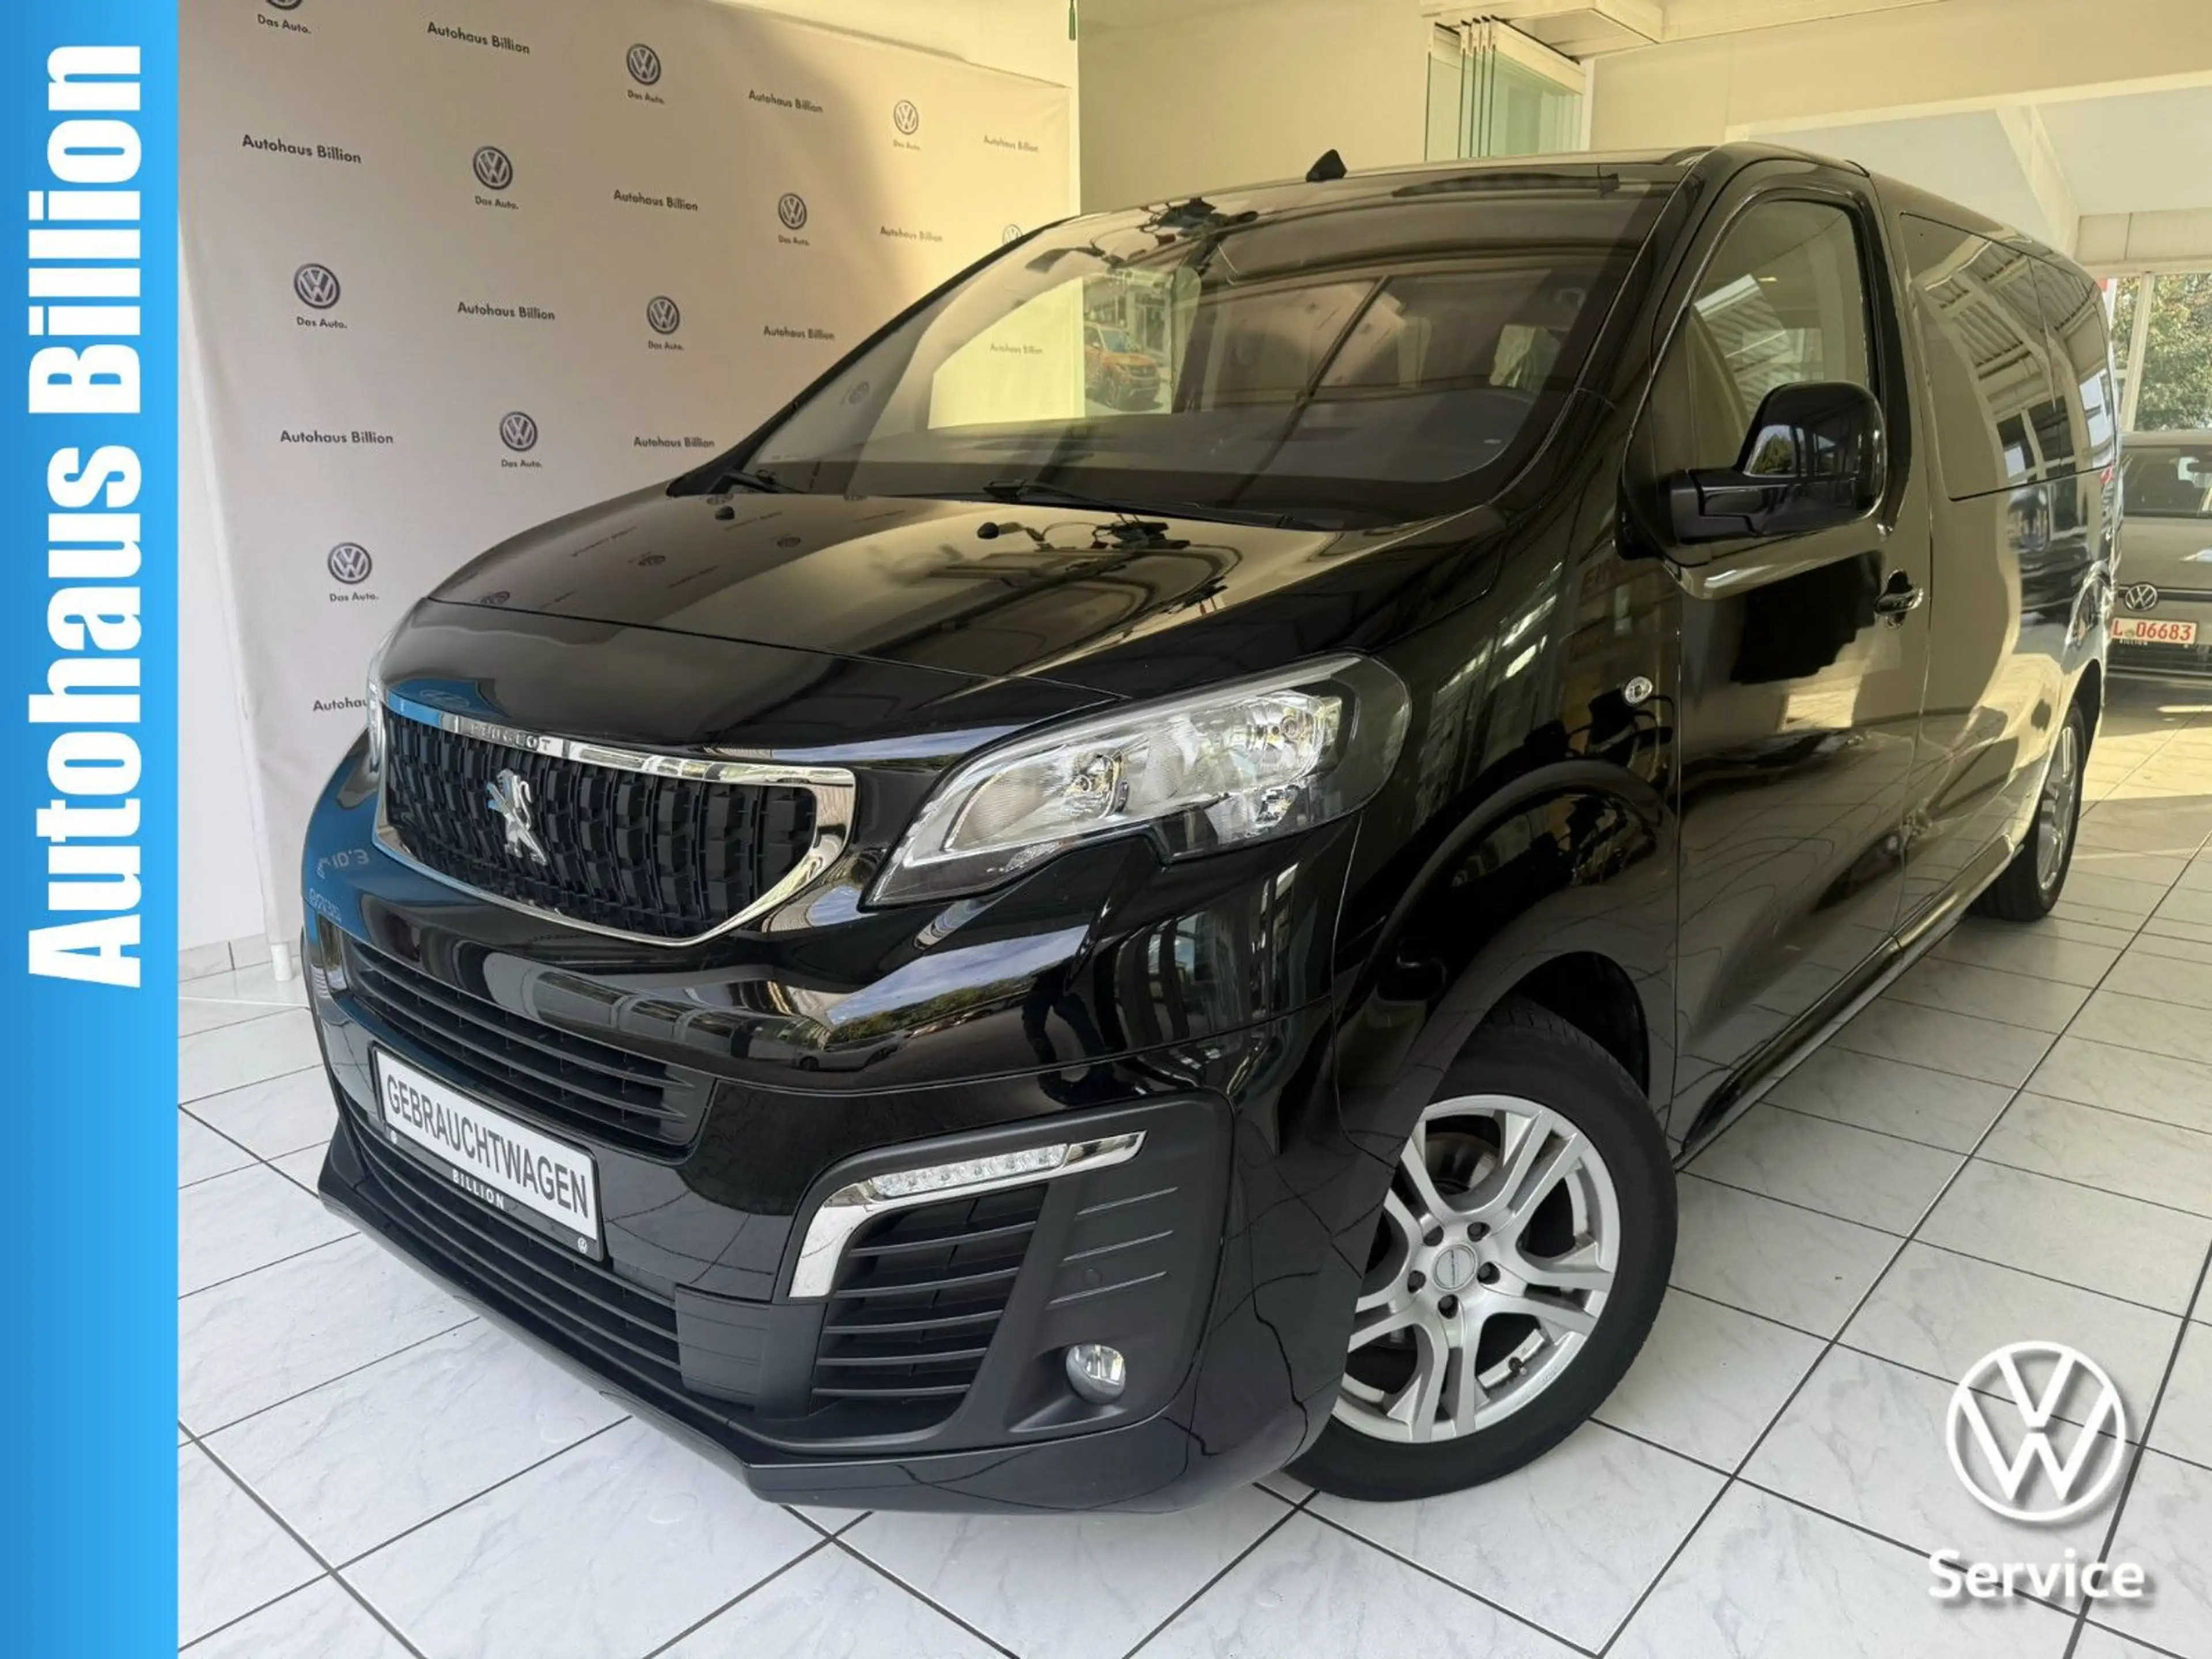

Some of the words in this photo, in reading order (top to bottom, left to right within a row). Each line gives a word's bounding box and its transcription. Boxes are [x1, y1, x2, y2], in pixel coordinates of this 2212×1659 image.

[257, 13, 279, 28] Das
[427, 21, 488, 46] Autohaus
[491, 35, 529, 54] Billion
[628, 89, 643, 100] Das
[748, 89, 793, 108] Autohaus
[795, 98, 823, 113] Billion
[243, 134, 312, 157] Autohaus
[317, 145, 361, 164] Billion
[475, 195, 492, 206] Das
[614, 189, 664, 207] Autohaus
[666, 196, 698, 211] Billion
[458, 301, 515, 317] Autohaus
[519, 306, 555, 320] Billion
[297, 316, 317, 327] Das
[648, 339, 662, 350] Das
[281, 430, 347, 444] Autohaus
[351, 430, 393, 444] Billion
[634, 435, 681, 448] Autohaus
[684, 436, 714, 448] Billion
[501, 459, 518, 468] Das
[329, 593, 349, 603] Das
[2113, 619, 2123, 637] L
[2135, 621, 2192, 641] 06683
[387, 1074, 589, 1218] GEBRAUCHTWAGEN
[452, 1168, 505, 1210] BILLION
